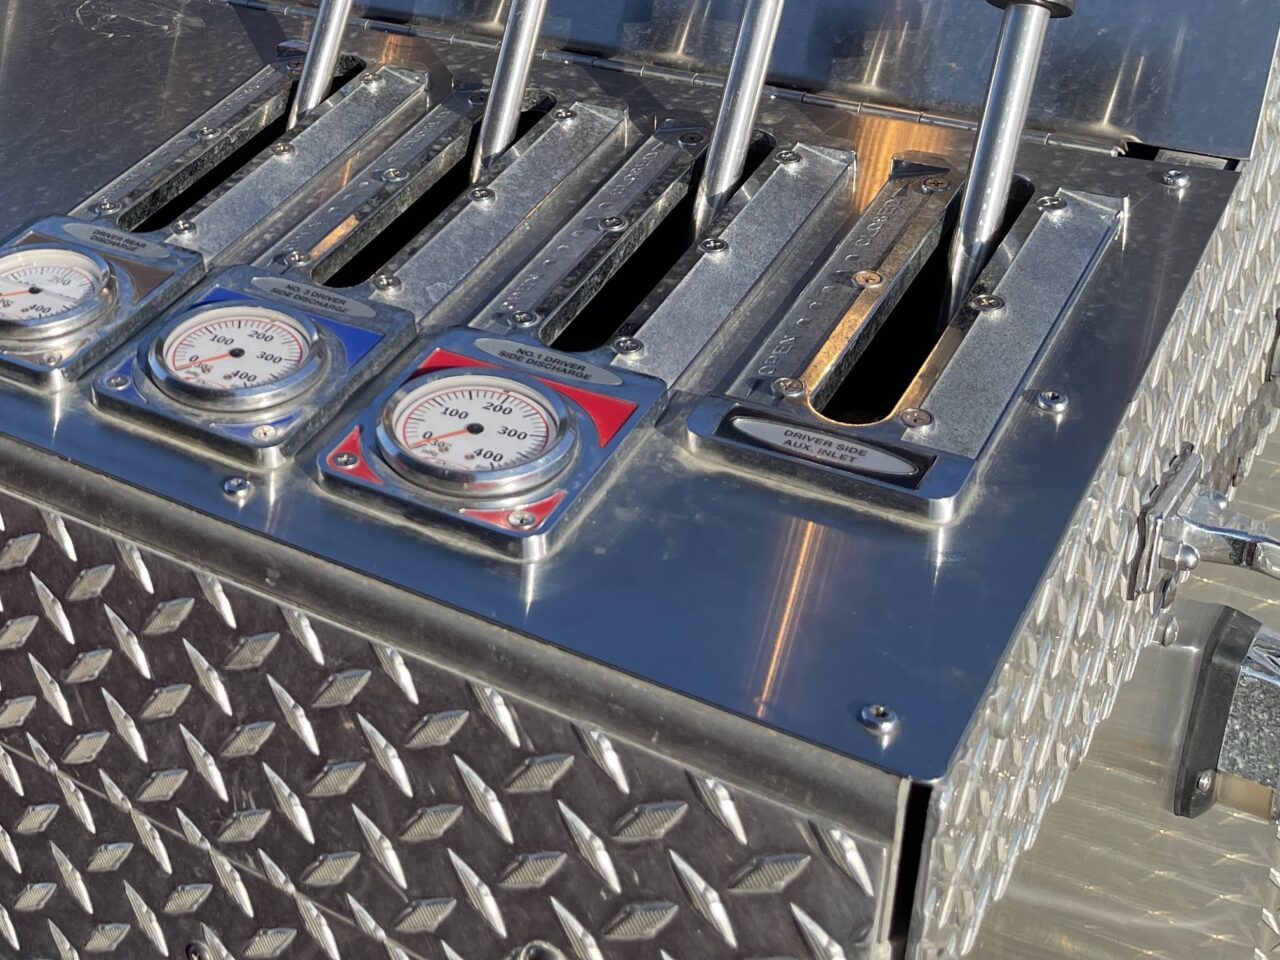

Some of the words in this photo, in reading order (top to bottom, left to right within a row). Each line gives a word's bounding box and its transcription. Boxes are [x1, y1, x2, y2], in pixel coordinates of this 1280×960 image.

[48, 275, 72, 286] 200
[270, 287, 291, 298] SIDE
[292, 292, 350, 313] DISCHARGE
[310, 290, 347, 305] DRIVER
[29, 304, 52, 313] 400
[209, 335, 234, 346] 100
[247, 330, 274, 343] 200
[256, 351, 282, 364] 300
[516, 347, 535, 358] NO.
[544, 355, 586, 372] DRIVER
[499, 350, 522, 362] SIDE
[526, 356, 592, 381] DISCHARGE
[231, 369, 258, 382] 400
[440, 406, 469, 420] 100
[482, 401, 513, 415] 200
[422, 431, 433, 439] 0
[498, 425, 528, 440] 300
[783, 429, 833, 447] DRIVER
[835, 443, 868, 457] SIDE
[473, 448, 504, 462] 400
[782, 439, 813, 453] AUX.
[817, 448, 858, 463] INLET
